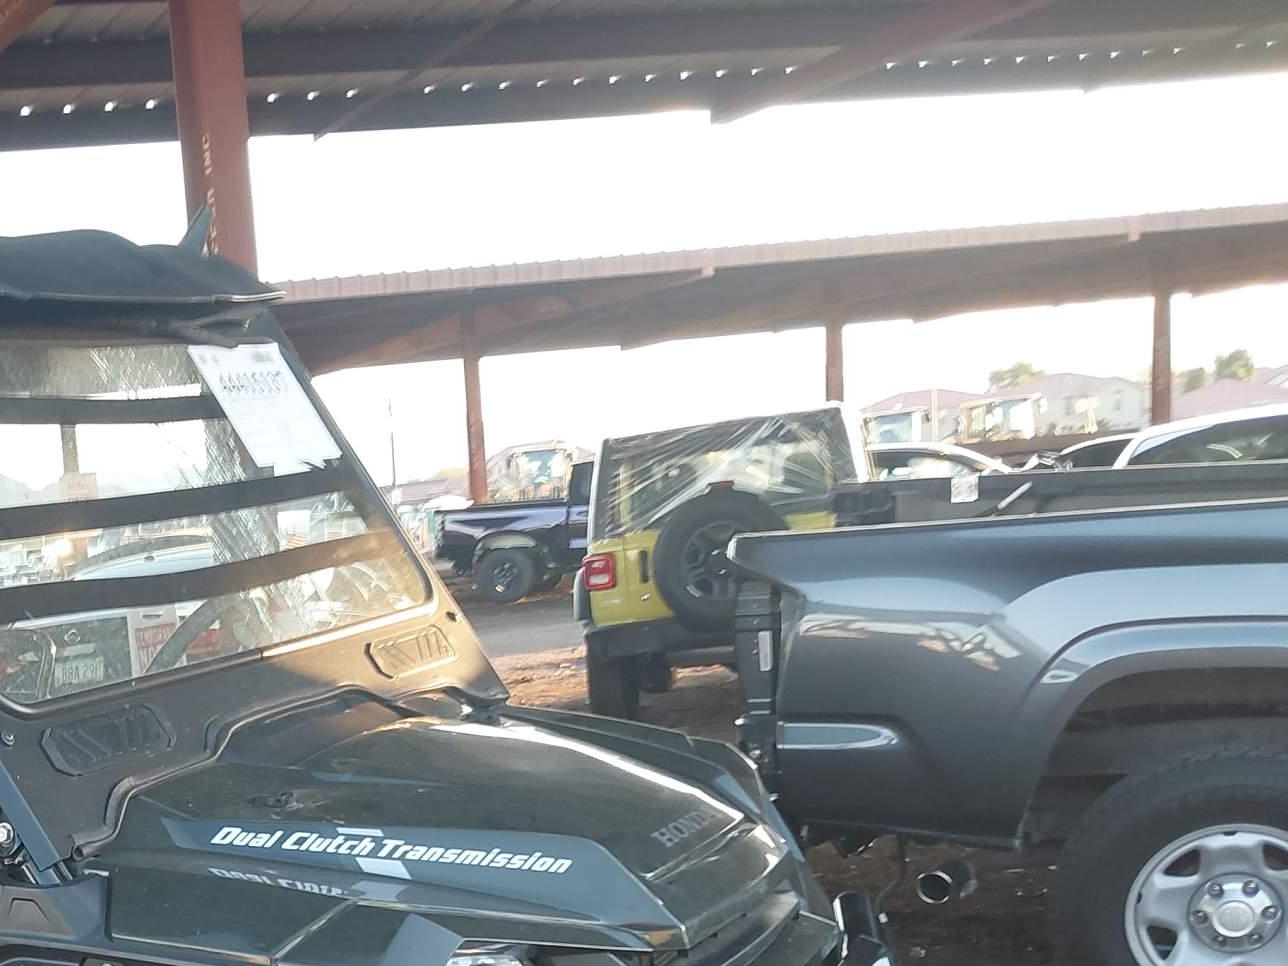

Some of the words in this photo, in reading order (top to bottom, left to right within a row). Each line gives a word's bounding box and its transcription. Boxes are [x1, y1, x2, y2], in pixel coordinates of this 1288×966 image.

[211, 826, 279, 848] Dual
[281, 831, 375, 858] Clutch
[383, 839, 572, 874] Transmission
